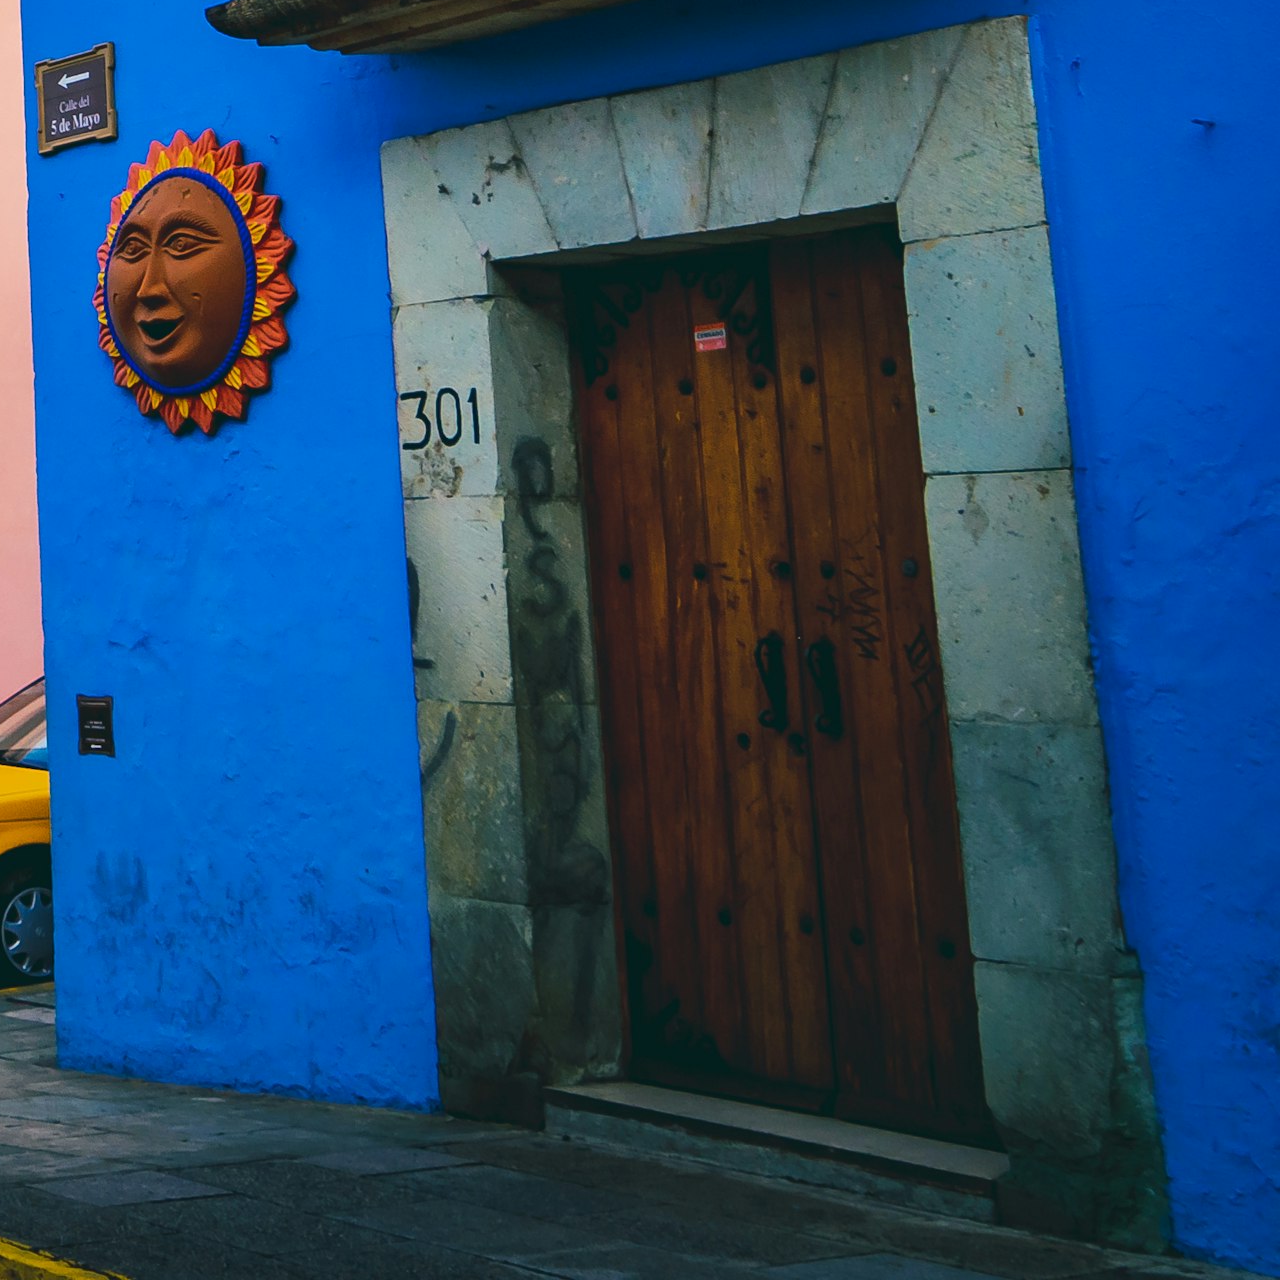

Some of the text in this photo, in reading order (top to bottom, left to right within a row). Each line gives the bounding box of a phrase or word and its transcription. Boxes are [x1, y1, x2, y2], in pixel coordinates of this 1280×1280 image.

[59, 95, 90, 114] Calle del
[51, 112, 101, 135] 5 de Mayo
[399, 387, 481, 451] 301
